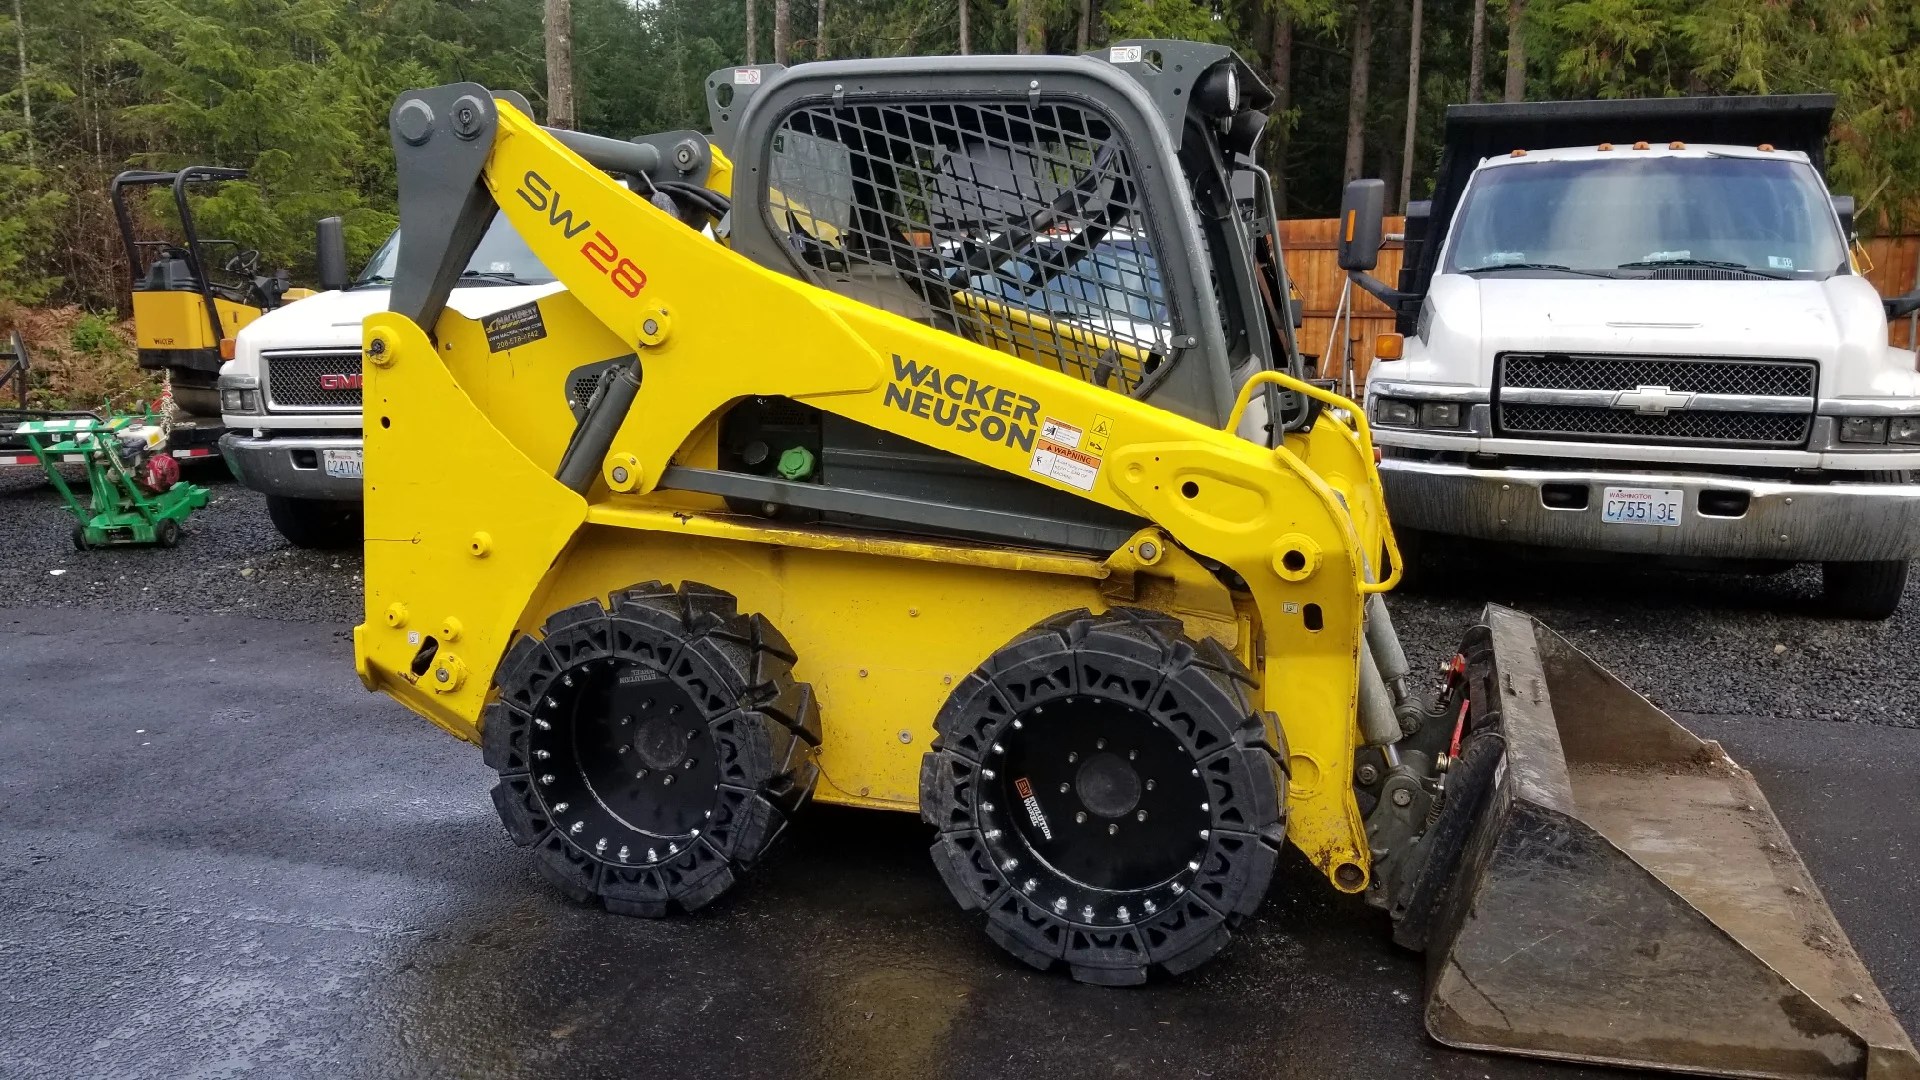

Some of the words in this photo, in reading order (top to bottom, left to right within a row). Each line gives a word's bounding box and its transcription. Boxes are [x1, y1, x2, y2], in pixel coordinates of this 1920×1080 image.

[891, 353, 1041, 427] WACKER
[883, 382, 1036, 453] NEUSON
[1054, 446, 1092, 465] WARNING
[1609, 492, 1652, 500] WASHINGTON
[1607, 500, 1677, 521] C75513E
